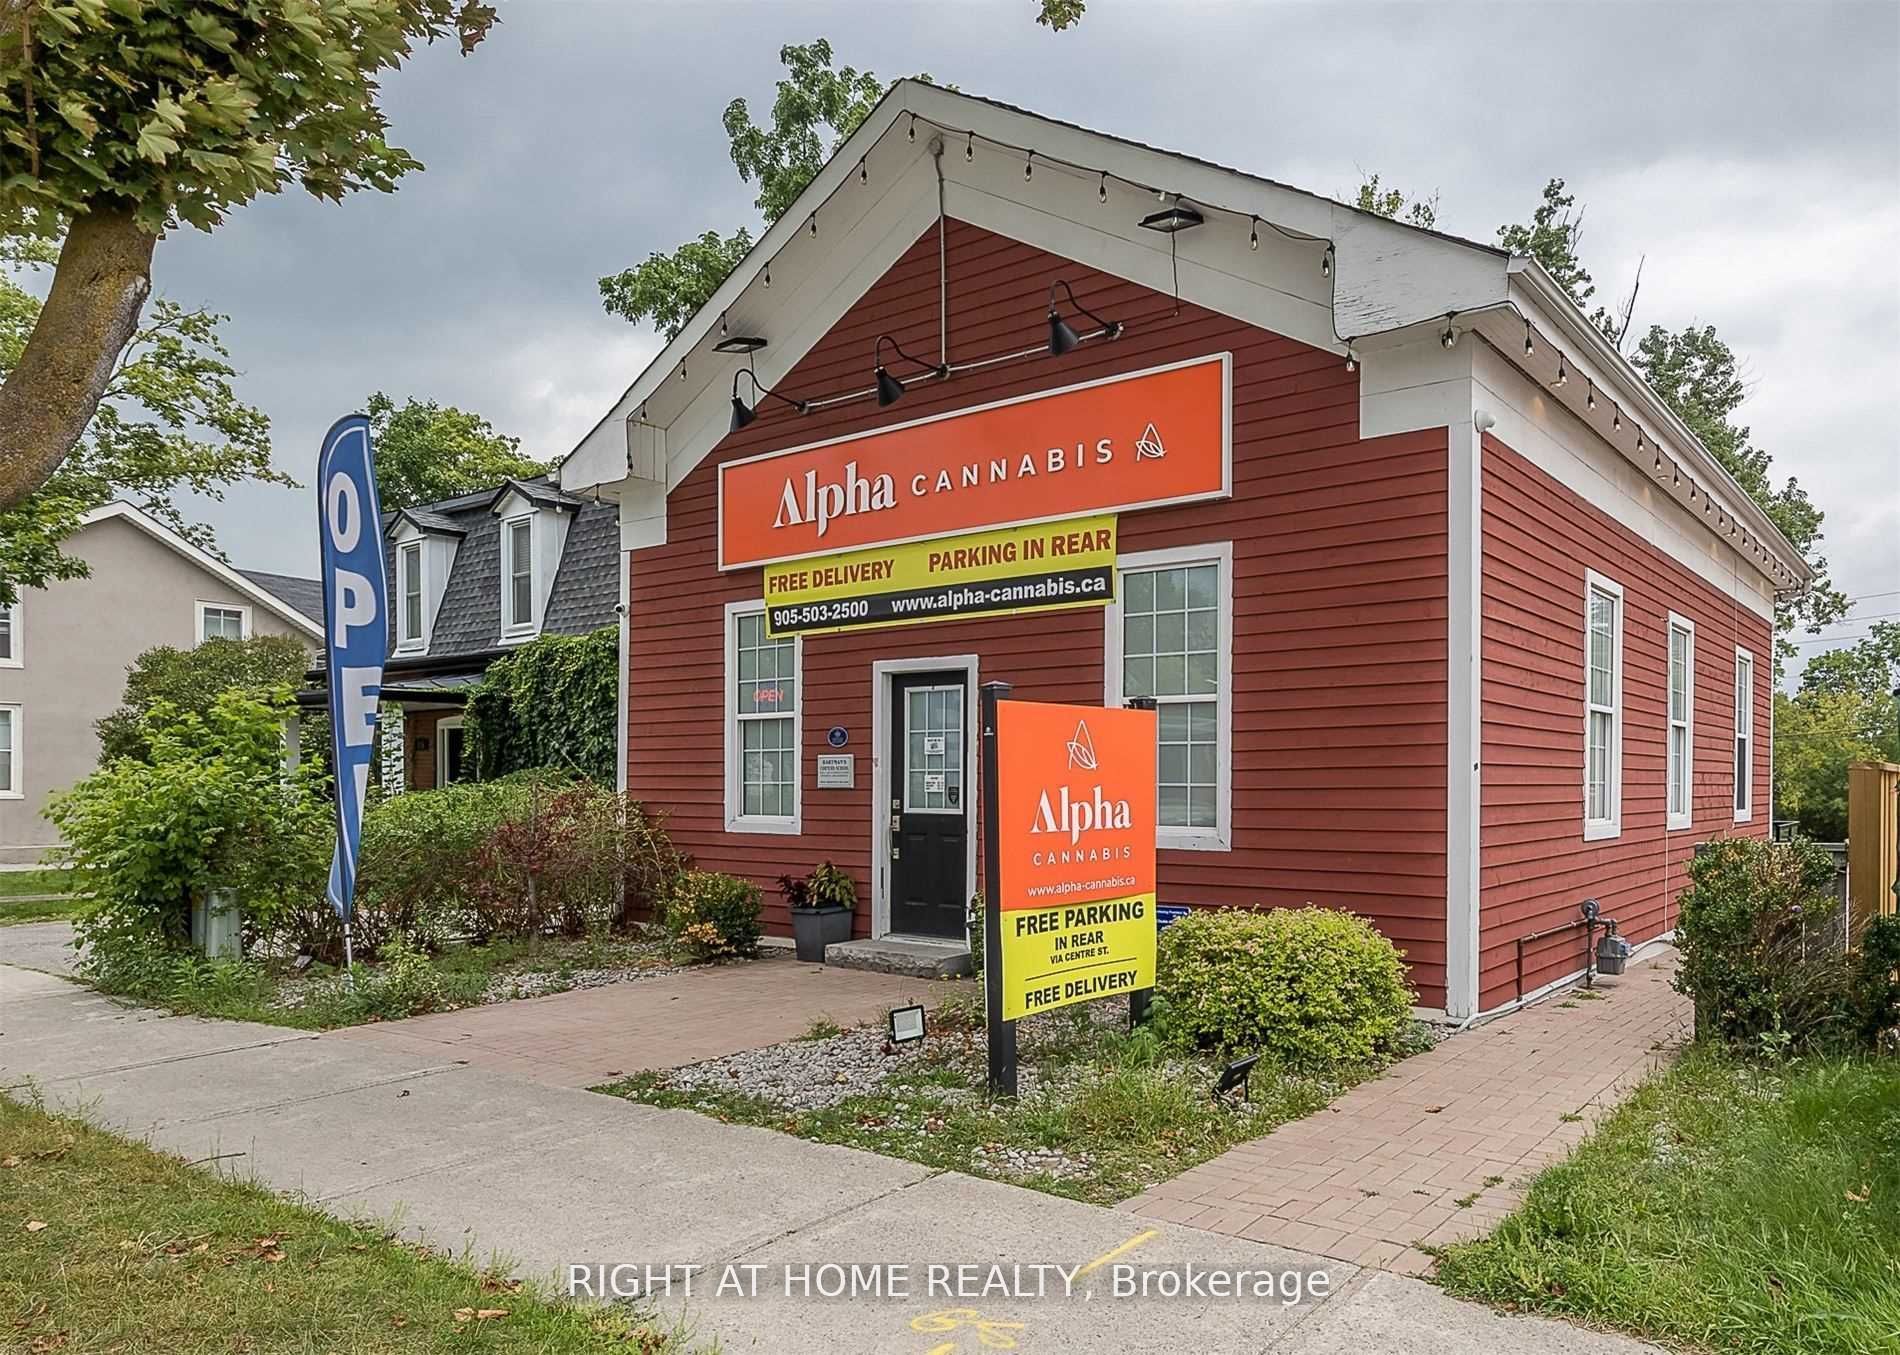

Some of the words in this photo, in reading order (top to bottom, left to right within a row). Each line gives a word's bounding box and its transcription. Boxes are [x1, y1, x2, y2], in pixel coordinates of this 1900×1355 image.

[772, 460, 896, 537] Alpha
[912, 438, 1113, 496] CANNABIS
[769, 569, 809, 594] FREE
[812, 559, 895, 588] DELIVERY
[928, 542, 1017, 573] PARKING
[1023, 540, 1045, 559] IN
[1051, 529, 1112, 556] REAR
[774, 600, 869, 627] 905-503-2500
[891, 574, 1106, 614] www.alpha-cannabis.ca
[1031, 785, 1132, 846] Alpha
[1033, 846, 1131, 866] CANNABIS
[1028, 875, 1136, 897] www.alpha-cannabis.ca
[1016, 911, 1059, 937] FREE
[1065, 900, 1144, 928] PARKING
[1050, 955, 1063, 965] VIA
[1065, 948, 1096, 962] CENTRE
[1098, 946, 1110, 957] ST.
[1055, 936, 1068, 950] IN
[1072, 930, 1104, 947] REAR
[1025, 988, 1061, 1009] FREE
[1065, 970, 1138, 999] DELIVERY
